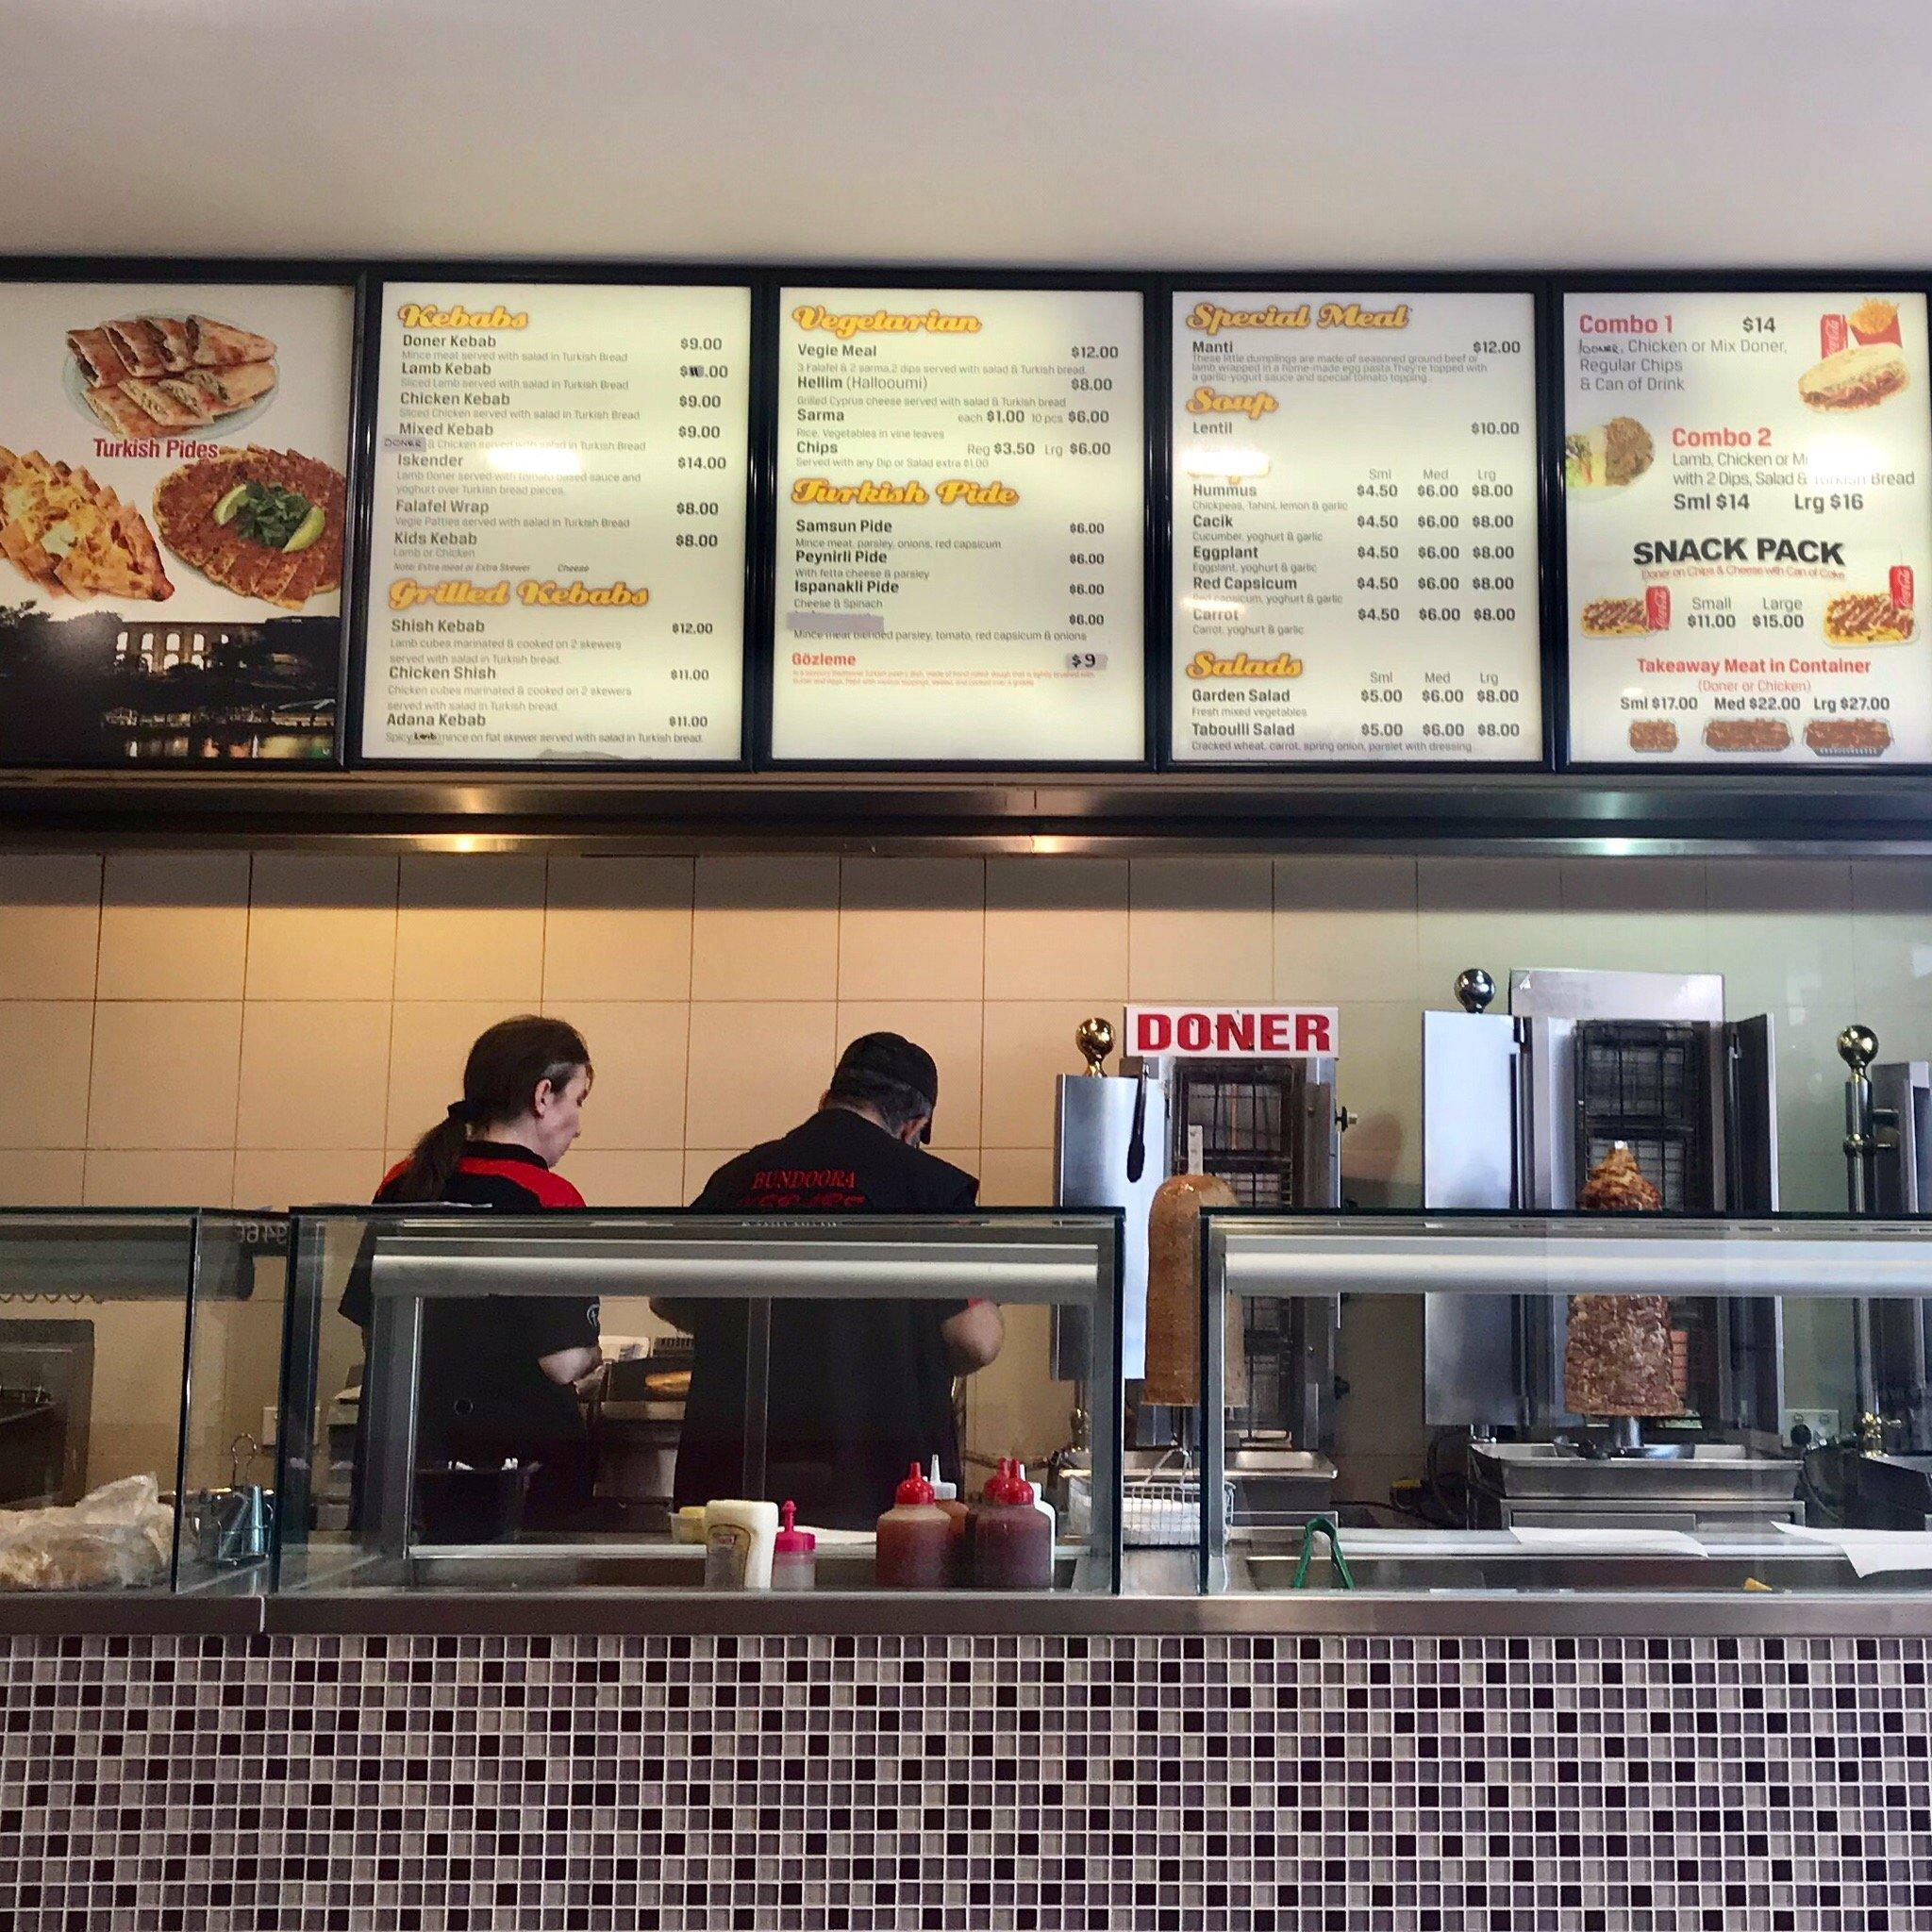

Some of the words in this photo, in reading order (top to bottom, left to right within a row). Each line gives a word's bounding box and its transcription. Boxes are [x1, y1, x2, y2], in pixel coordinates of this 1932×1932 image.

[398, 304, 528, 329] Kebabs
[791, 305, 982, 339] Vegetarian
[1186, 302, 1310, 336] Special
[1317, 304, 1409, 329] Meal
[1580, 315, 1658, 333] Combo
[1664, 316, 1673, 333] 1
[1742, 316, 1775, 333] $14
[404, 335, 446, 347] Doner
[451, 336, 496, 347] Kebab
[681, 337, 722, 350] $9.00
[1192, 341, 1233, 354] Manti
[1474, 341, 1521, 354] $12.00
[1628, 340, 1687, 353] Chicken
[1691, 343, 1706, 353] or
[1711, 341, 1736, 353] Mix
[798, 344, 839, 359] Vegie
[842, 345, 876, 357] Meal
[1072, 346, 1118, 359] $12.00
[402, 362, 441, 375] Lamb
[445, 363, 491, 375] Kebab
[1580, 359, 1636, 375] Regular
[1641, 359, 1682, 375] Chips
[798, 376, 842, 389] Hellim
[1072, 378, 1112, 391] $8.00
[1581, 378, 1591, 391] &
[1596, 378, 1624, 391] Can
[1628, 378, 1642, 391] of
[1648, 378, 1684, 391] Drink
[401, 392, 459, 406] Chicken
[464, 393, 509, 406] Kebab
[679, 395, 721, 408] $9.00
[1186, 387, 1279, 421] Soup
[797, 409, 844, 422] Sarma
[958, 414, 982, 423] each
[987, 410, 1025, 424] $1.00
[1069, 410, 1109, 424] $6.00
[399, 424, 443, 435] Mixed
[447, 424, 493, 435] Kebab
[1193, 423, 1232, 435] Lentil
[1472, 423, 1519, 435] $10.00
[1673, 428, 1751, 447] Combo
[1757, 428, 1772, 446] 2
[93, 439, 160, 458] Turkish
[166, 440, 219, 459] Pides
[797, 441, 838, 457] Chips
[968, 443, 990, 457] Reg
[994, 442, 1035, 456] $3.50
[1045, 444, 1062, 457] Lrg
[399, 454, 462, 467] Iskender
[678, 457, 726, 470] $14.00
[1718, 453, 1772, 466] Chicken
[1776, 457, 1790, 466] or
[1369, 469, 1391, 480] Sml
[1424, 469, 1448, 480] Med
[1477, 469, 1496, 482] Lrg
[1674, 473, 1703, 485] with
[1707, 473, 1715, 485] 2
[1757, 473, 1794, 485] Salad
[791, 478, 929, 506] Turkish
[937, 479, 1020, 507] Pide
[1192, 485, 1257, 497] Hummus
[1357, 485, 1398, 497] $4.50
[1418, 485, 1458, 497] $6.00
[1473, 485, 1513, 497] $8.00
[396, 500, 447, 513] Falafel
[450, 501, 489, 517] Wrap
[1674, 493, 1711, 510] Sml
[1717, 492, 1749, 510] $14
[1794, 494, 1824, 514] Lrg
[1830, 493, 1863, 510] $16
[796, 520, 857, 533] Samsun
[860, 520, 892, 533] Pide
[1192, 516, 1233, 527] Cacik
[394, 532, 426, 545] Kids
[430, 533, 477, 545] Kebab
[796, 539, 824, 548] Mince
[935, 540, 951, 549] red
[954, 540, 1002, 551] capsicum
[795, 550, 851, 566] Peynirli
[855, 551, 887, 563] Pide
[1193, 546, 1258, 561] Eggplant
[1357, 546, 1398, 559] $4.50
[1418, 546, 1459, 559] $6.00
[1473, 546, 1514, 559] $8.00
[1634, 538, 1748, 566] SNACK
[1757, 539, 1845, 566] PACK
[795, 569, 817, 578] With
[846, 569, 881, 578] cheese
[884, 570, 891, 578] &
[893, 570, 929, 581] parsley
[867, 581, 899, 593] Pide
[1193, 577, 1221, 590] Red
[1224, 577, 1297, 592] Capsicum
[389, 578, 510, 611] Grilled
[517, 580, 649, 607] Kebabs
[794, 599, 831, 608] Cheese
[834, 600, 841, 608] &
[843, 599, 883, 610] Spinach
[1692, 598, 1731, 610] Small
[1763, 598, 1803, 612] Large
[1193, 609, 1239, 621] Carrot
[1688, 615, 1736, 628] $11.00
[1753, 615, 1804, 628] $15.00
[391, 619, 434, 633] Shish
[439, 620, 484, 633] Kebab
[389, 666, 449, 679] Chicken
[454, 667, 496, 679] Shish
[1186, 651, 1303, 680] Salads
[1638, 659, 1720, 675] Takeaway
[1724, 659, 1766, 673] Meat
[1771, 659, 1785, 673] in
[1790, 659, 1872, 674] Container
[1371, 672, 1392, 683] Sml
[1425, 673, 1450, 683] Med
[1480, 673, 1498, 686] Lrg
[1742, 683, 1754, 692] or
[1192, 690, 1245, 702] Garden
[1249, 690, 1290, 702] Salad
[1361, 690, 1403, 703] $5.00
[1422, 690, 1463, 703] $6.00
[1477, 690, 1519, 703] $8.00
[1621, 698, 1648, 710] Sml
[1652, 697, 1698, 710] $17.00
[1715, 698, 1745, 710] Med
[1749, 698, 1800, 710] $22.00
[1814, 698, 1837, 713] Lrg
[1840, 697, 1890, 710] $27.00
[387, 714, 435, 726] Adana
[439, 714, 486, 726] Kebab
[1192, 708, 1219, 717] Fresh
[1222, 708, 1250, 717] mixed
[1253, 708, 1307, 718] vegetables
[1192, 724, 1250, 736] Taboulli
[1254, 724, 1294, 736] Salad
[1138, 1013, 1330, 1051] DONER
